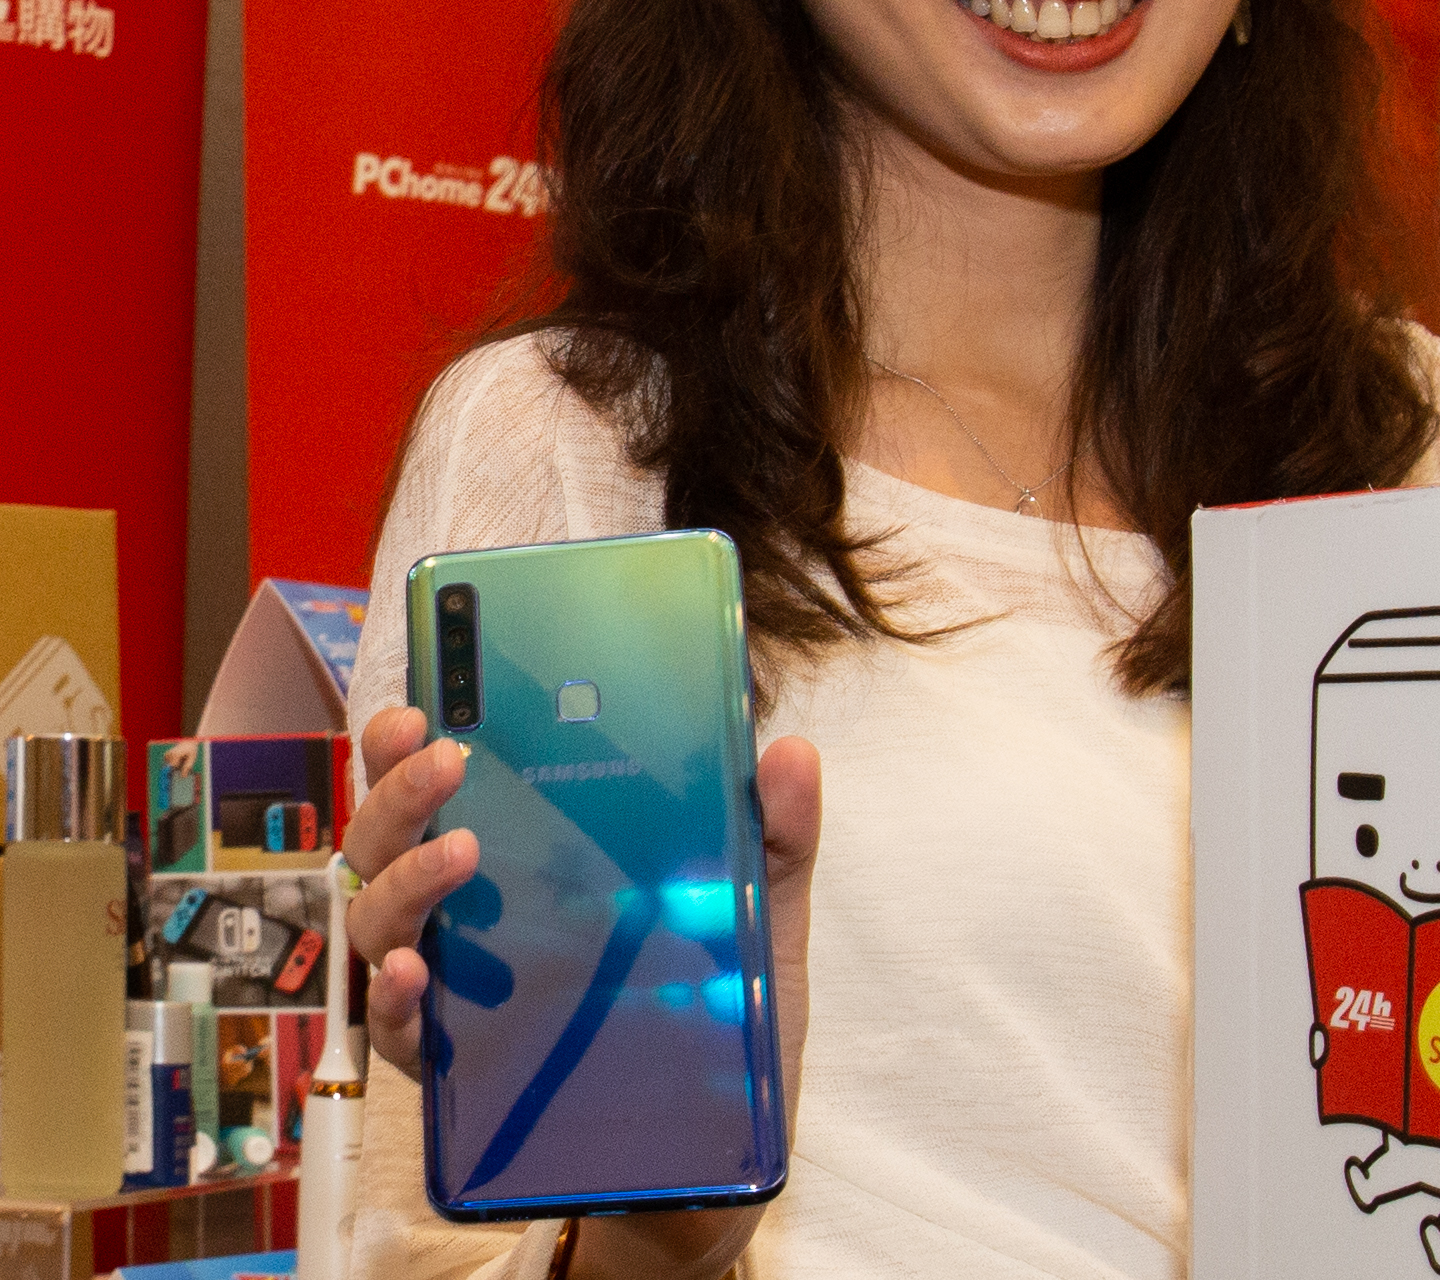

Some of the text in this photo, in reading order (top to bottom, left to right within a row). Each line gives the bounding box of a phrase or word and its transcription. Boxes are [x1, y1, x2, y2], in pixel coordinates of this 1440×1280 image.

[352, 152, 484, 208] PChome
[522, 759, 642, 784] SAMSUNG
[1329, 985, 1395, 1031] 24h
